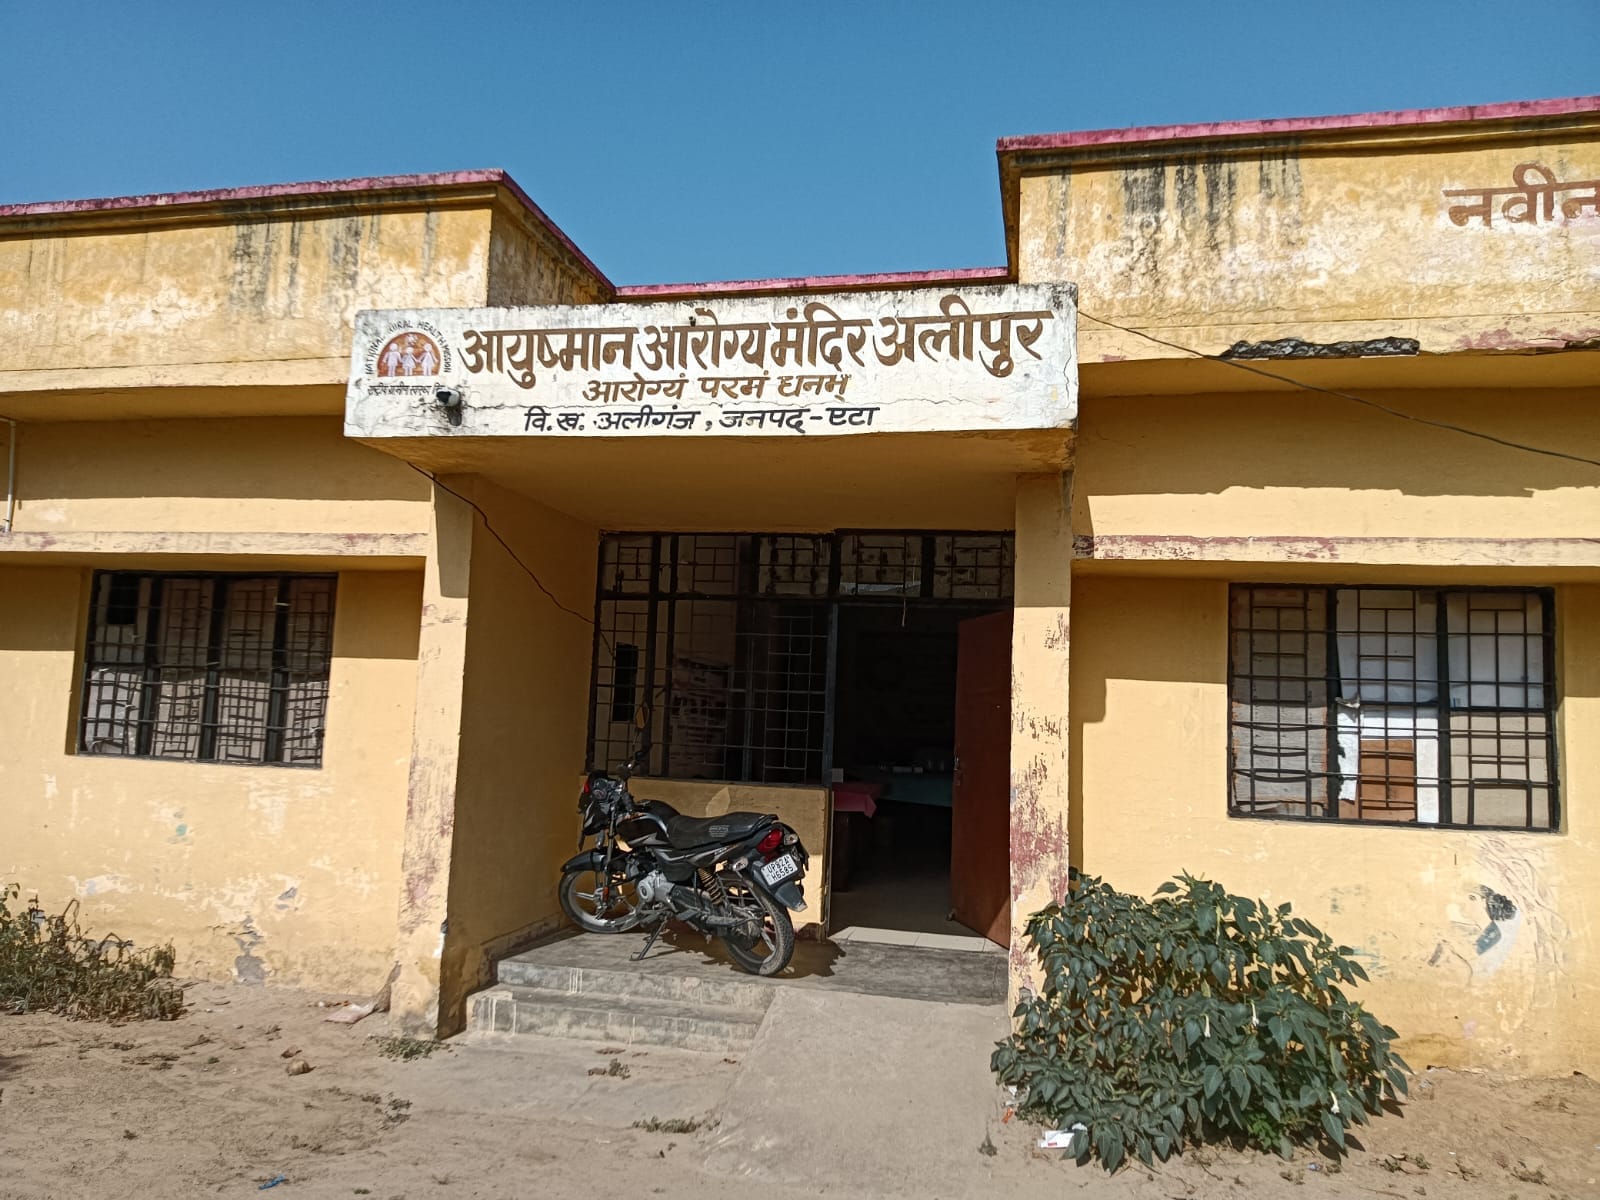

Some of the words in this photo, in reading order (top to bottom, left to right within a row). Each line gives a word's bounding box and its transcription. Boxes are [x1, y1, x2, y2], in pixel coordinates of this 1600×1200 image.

[417, 321, 447, 347] HEALTH
[457, 327, 639, 390] आयुष्मान
[637, 307, 772, 371] आरोग्य
[770, 302, 873, 371] मंदिर
[873, 294, 1055, 378] अलीपुर
[582, 372, 689, 403] आरोग्यं
[698, 369, 770, 399] परमं
